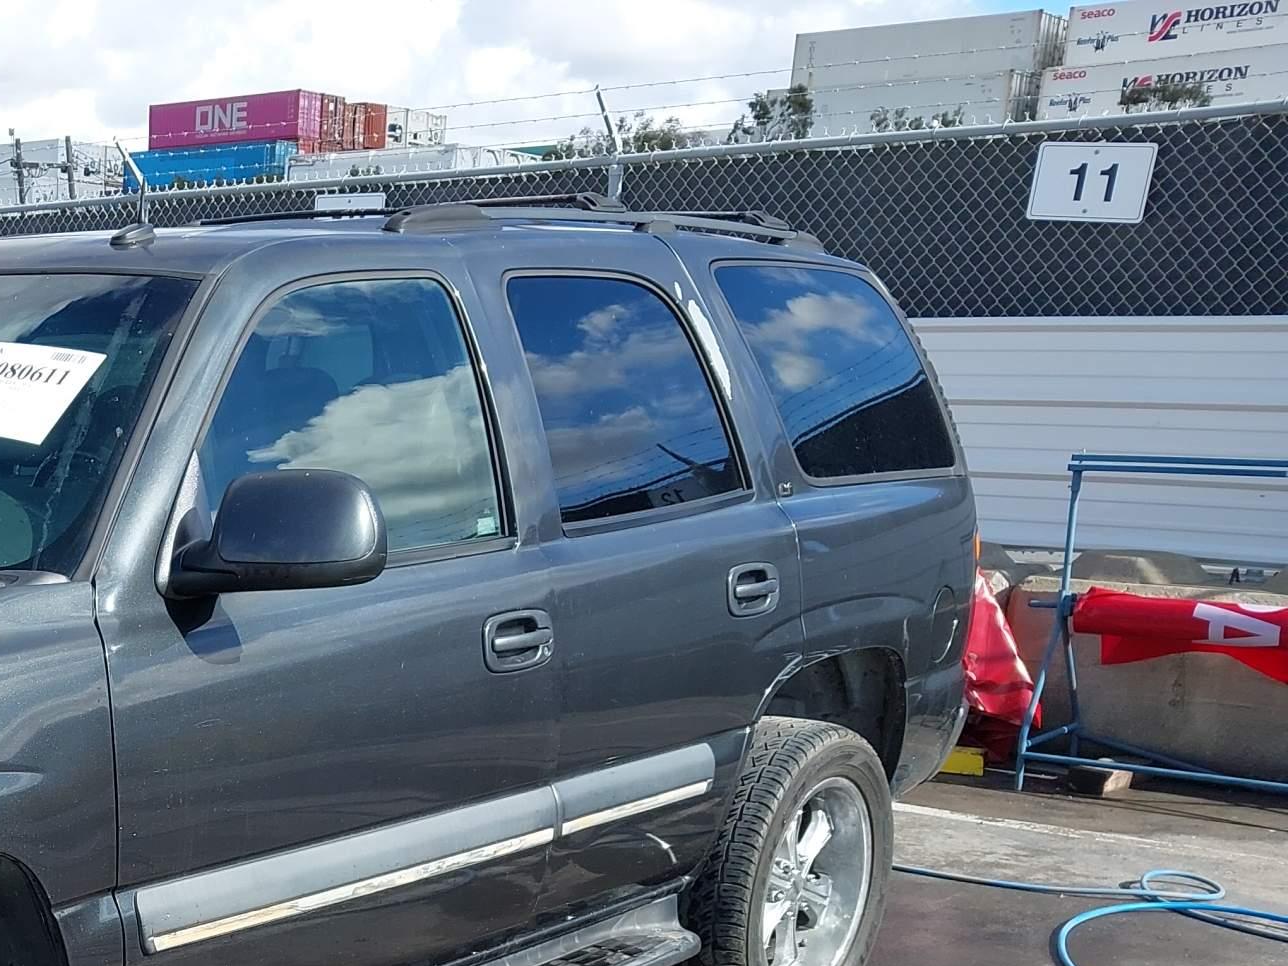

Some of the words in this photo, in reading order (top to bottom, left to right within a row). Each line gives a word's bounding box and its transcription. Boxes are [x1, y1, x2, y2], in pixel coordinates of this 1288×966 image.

[1080, 8, 1116, 20] seaco
[1184, 0, 1281, 24] HORIZON
[1182, 17, 1264, 35] LINES
[1053, 70, 1087, 81] seaco
[1155, 65, 1250, 87] HORIZON
[195, 102, 248, 131] ONE
[1069, 163, 1120, 202] 11
[1192, 603, 1281, 648] A
